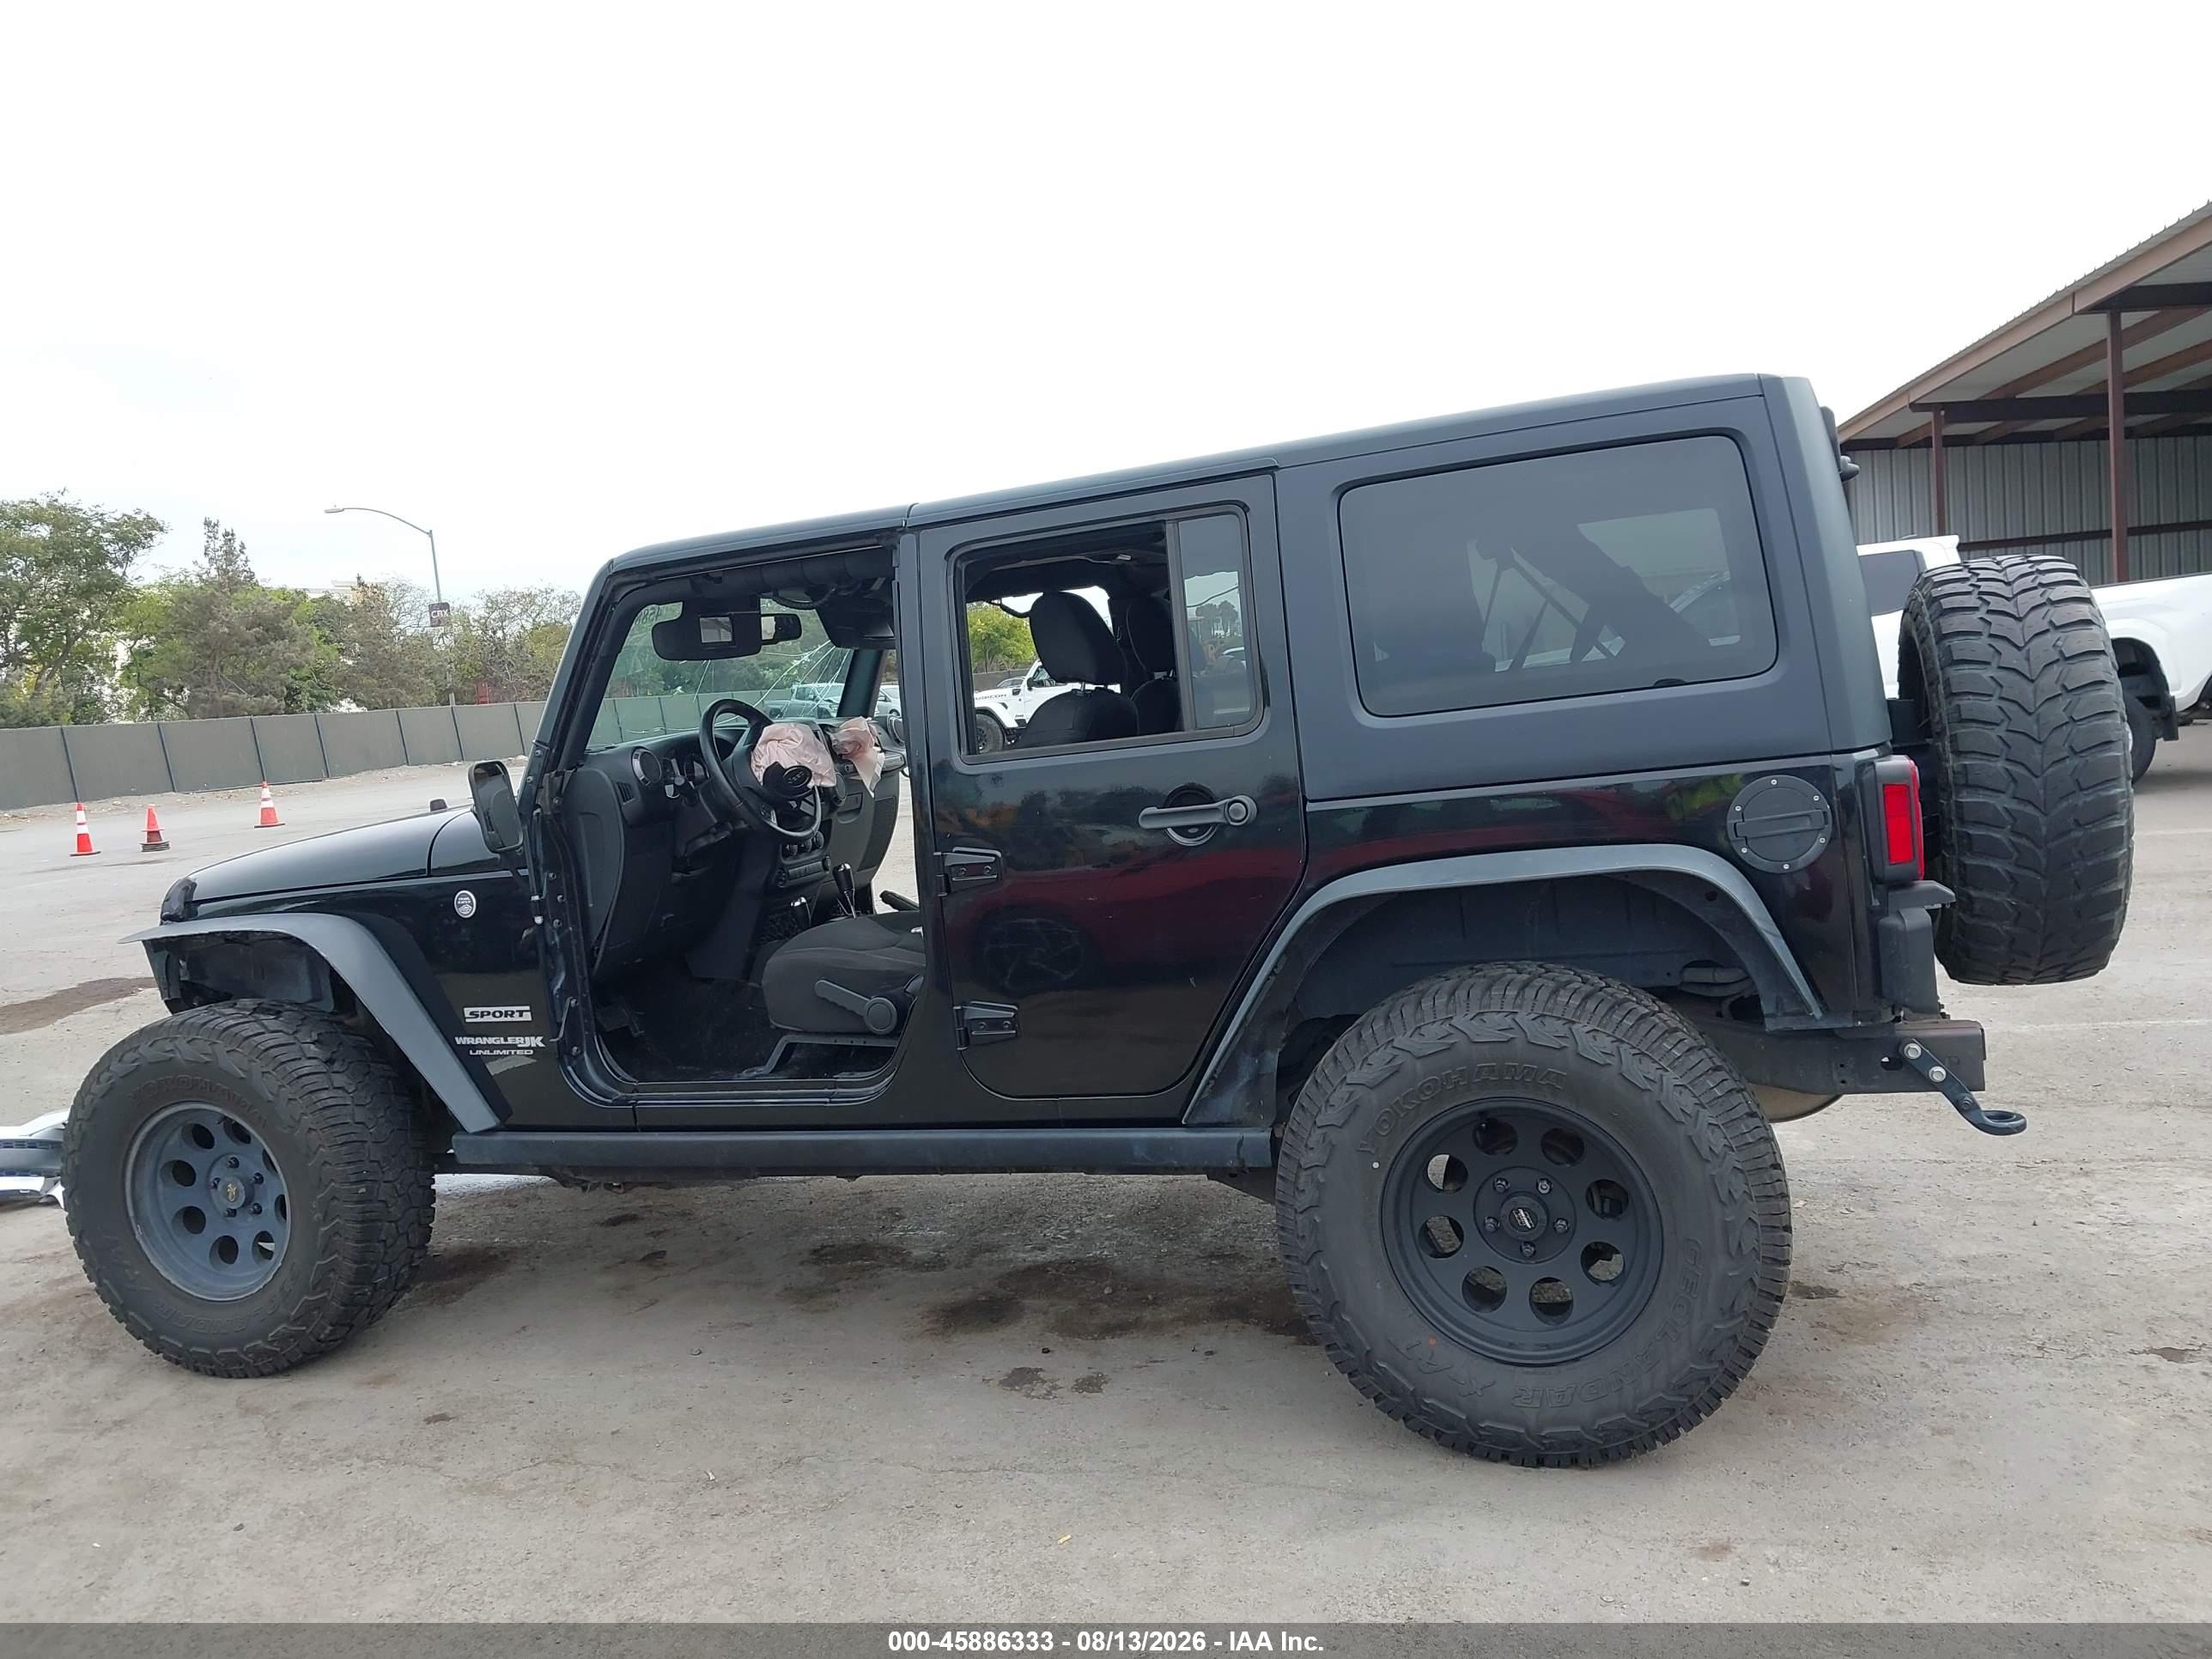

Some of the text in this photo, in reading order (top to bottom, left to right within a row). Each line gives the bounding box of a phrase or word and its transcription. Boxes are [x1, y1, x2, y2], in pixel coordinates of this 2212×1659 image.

[466, 1009, 529, 1019] SPORT
[1357, 1062, 1567, 1155] YOKOHAMA
[1511, 1237, 1704, 1408] GEOLANDAR
